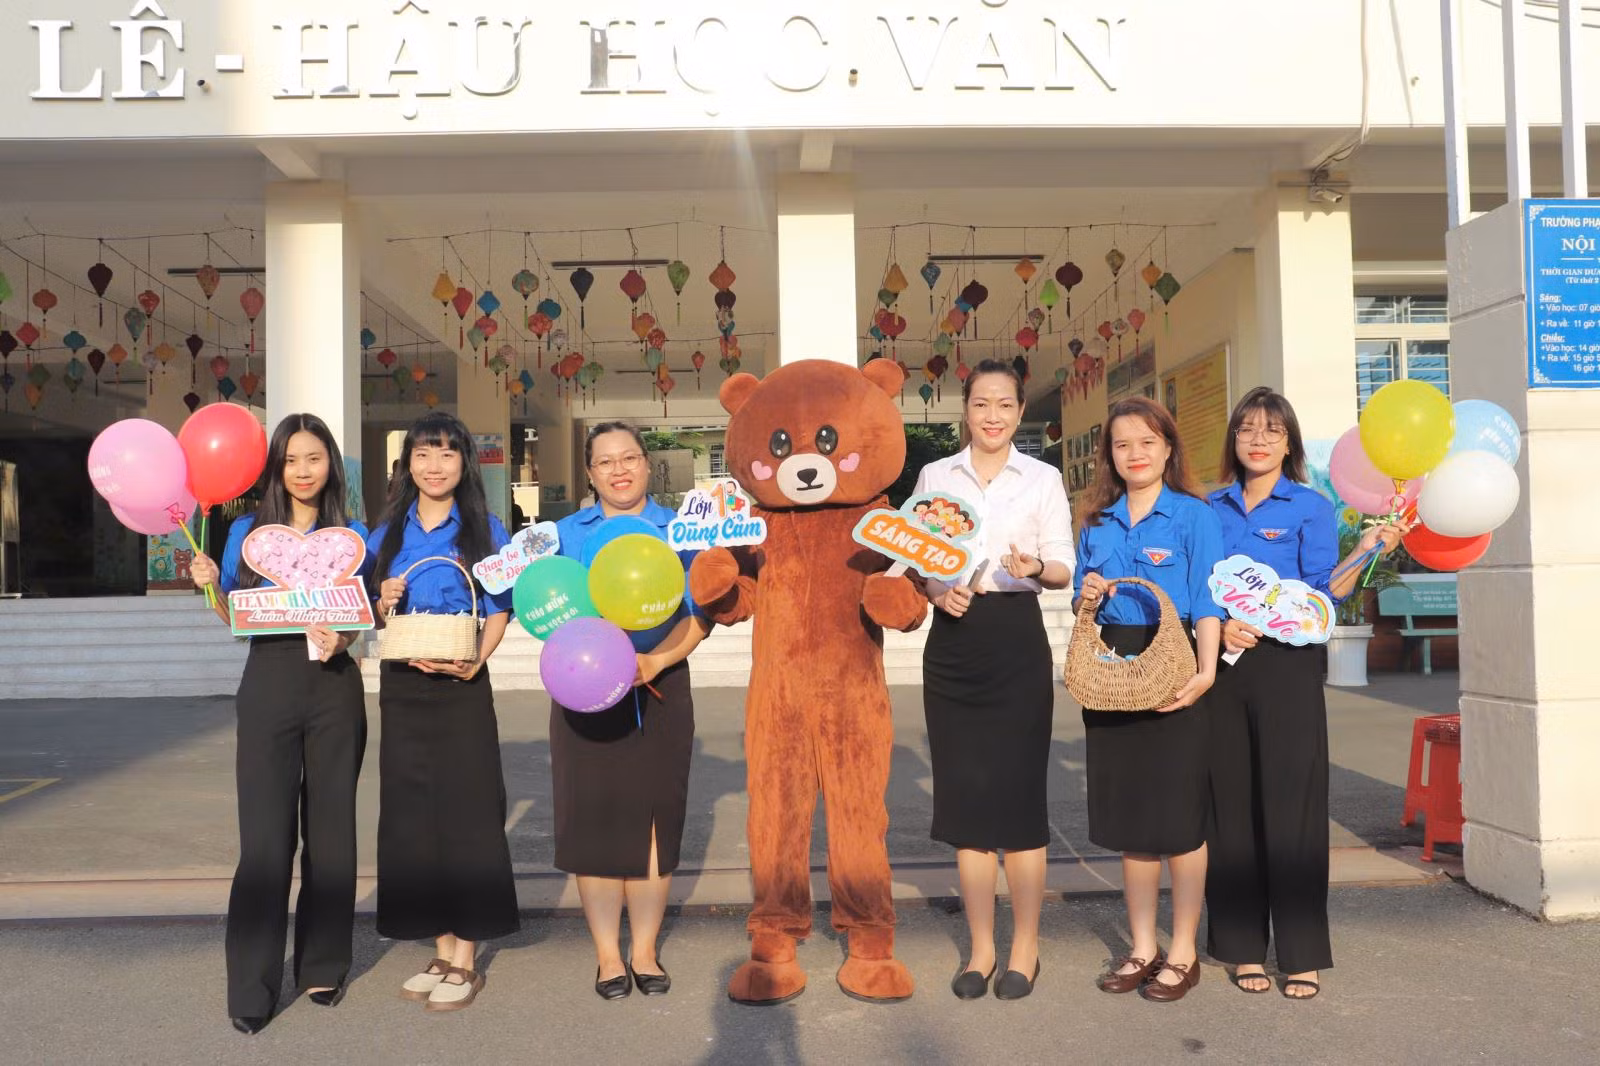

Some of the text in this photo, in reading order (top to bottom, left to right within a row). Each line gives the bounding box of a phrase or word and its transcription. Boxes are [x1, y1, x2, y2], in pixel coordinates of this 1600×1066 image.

[272, 1, 532, 120] HẬU
[579, 15, 831, 116] HỌC
[1541, 215, 1581, 228] TRƯỜNG
[1561, 234, 1596, 254] NỘI
[1563, 268, 1583, 276] GIAN
[1547, 319, 1557, 327] Ra
[1574, 319, 1582, 327] 11
[1547, 353, 1558, 361] Ra
[1579, 344, 1587, 352] 14
[684, 482, 726, 520] Lớp 1
[672, 513, 761, 547] Dũng Cảm
[868, 520, 960, 571] SÁNG TẠO
[1233, 567, 1268, 592] Lớp
